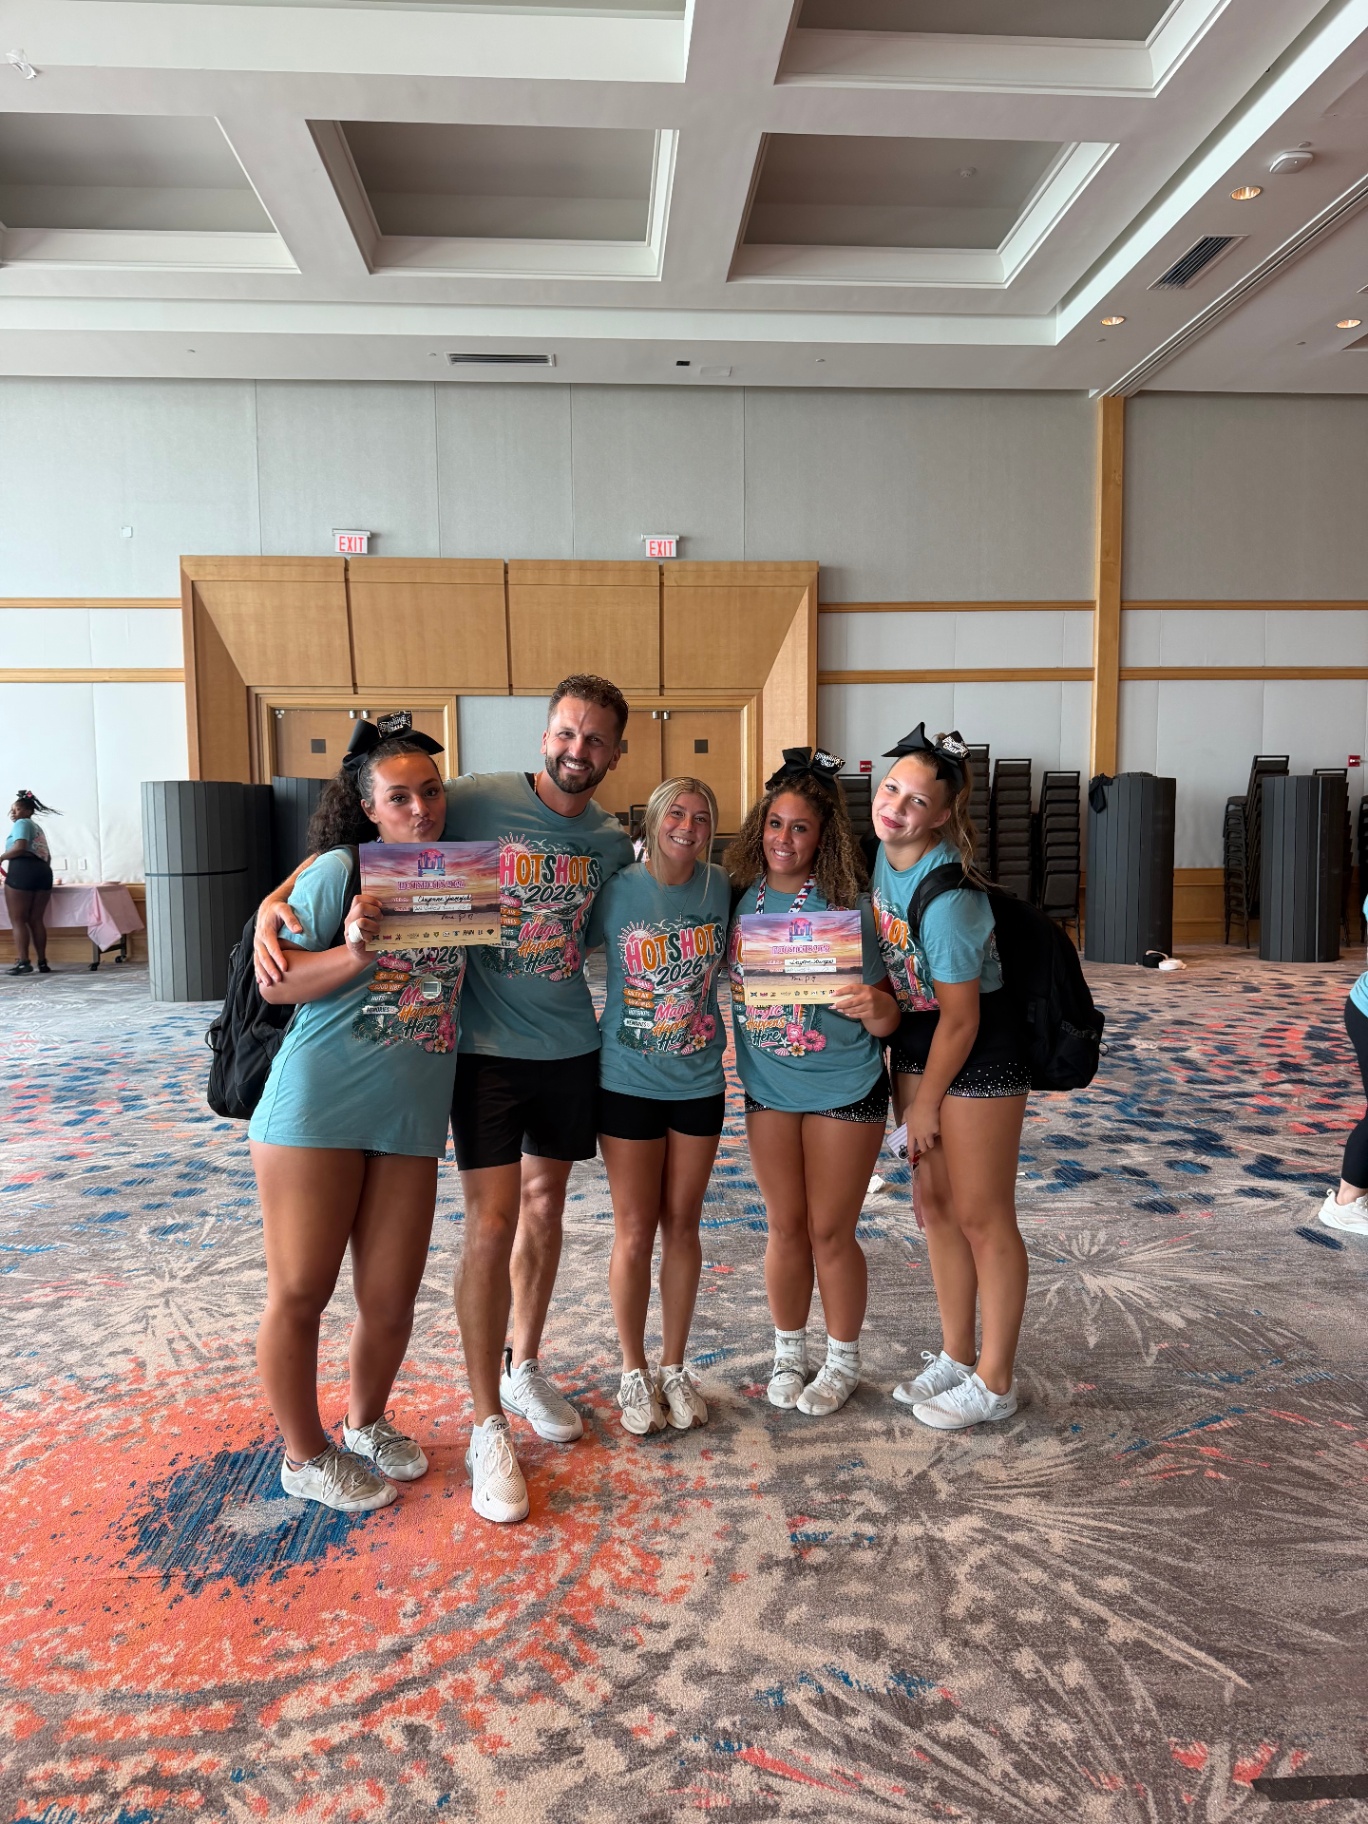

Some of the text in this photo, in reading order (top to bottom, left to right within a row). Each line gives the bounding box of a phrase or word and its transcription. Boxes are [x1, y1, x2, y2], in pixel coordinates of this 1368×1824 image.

[339, 535, 364, 552] EXIT
[649, 540, 673, 556] EXIT
[500, 853, 600, 889] HOTSHOTS
[523, 885, 577, 904] 2026
[518, 921, 563, 941] Magic
[518, 934, 566, 958] Happens
[625, 923, 726, 975] HOTSHOTS
[524, 951, 560, 973] Here
[655, 956, 703, 988] 2026
[654, 999, 695, 1022] Magic
[403, 1019, 438, 1040] Here
[746, 1017, 786, 1034] Happens
[752, 1030, 782, 1048] Here
